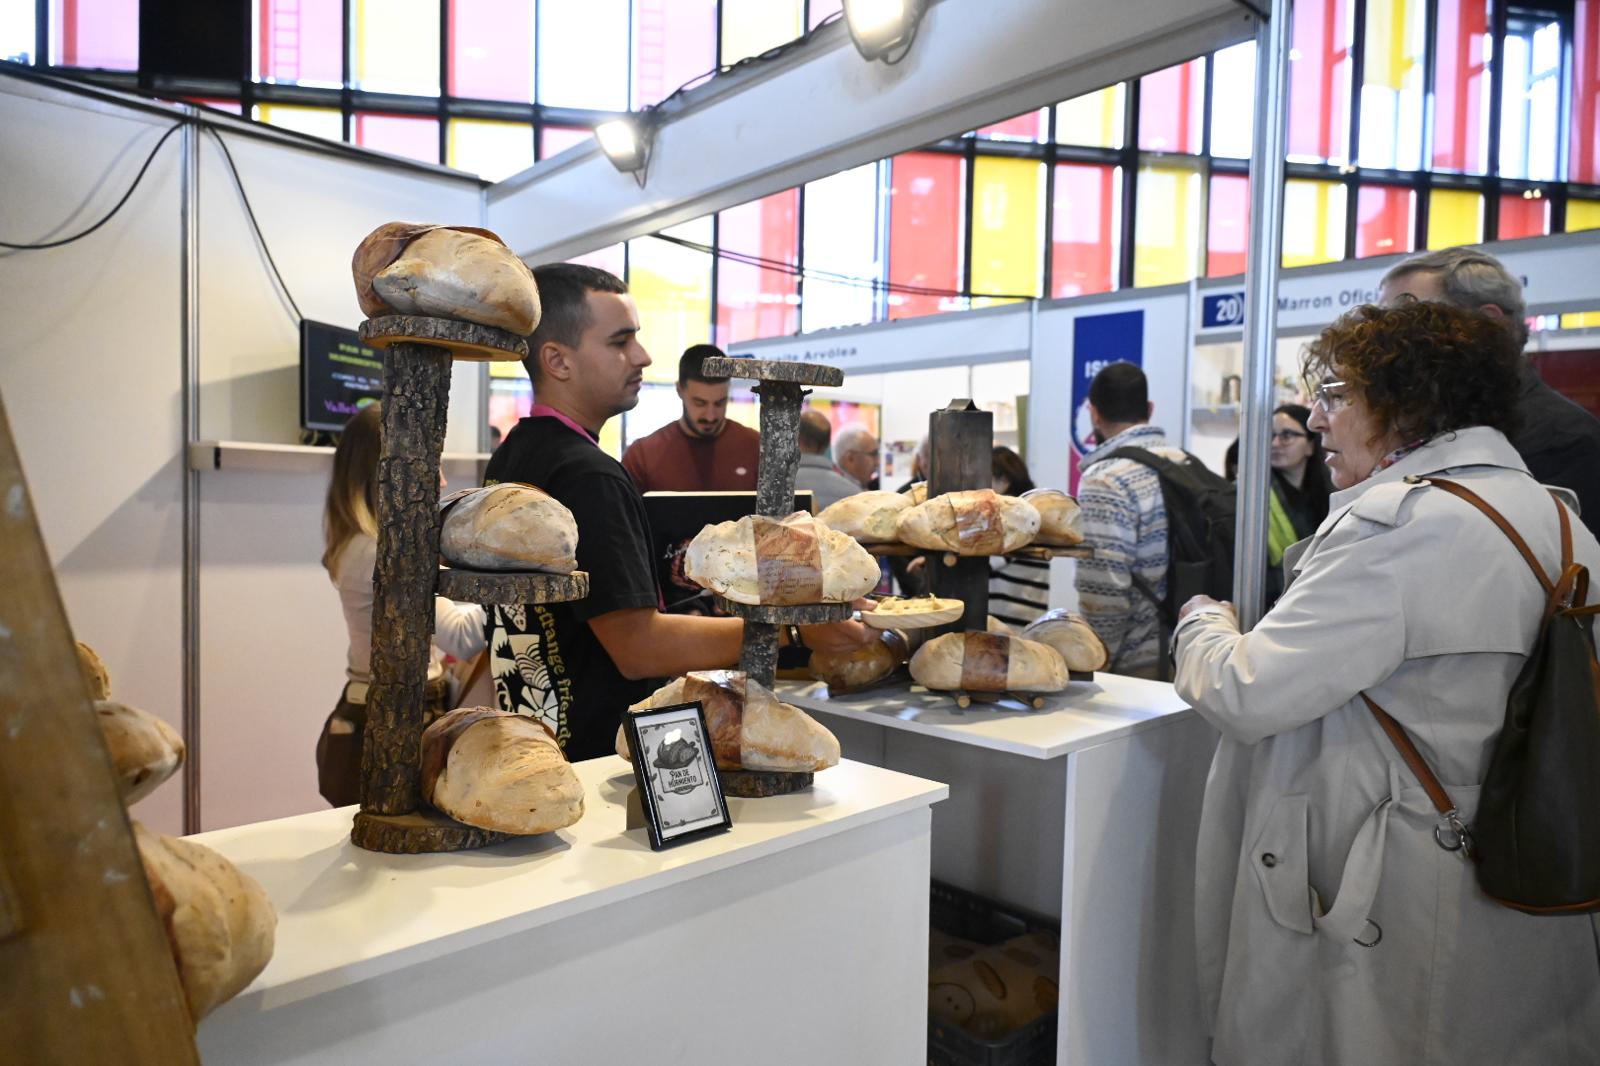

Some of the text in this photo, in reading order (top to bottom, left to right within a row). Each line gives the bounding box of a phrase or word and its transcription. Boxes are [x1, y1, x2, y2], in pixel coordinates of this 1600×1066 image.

[1216, 299, 1238, 322] 20
[1278, 289, 1378, 311] Marron Ofici
[534, 605, 566, 675] strange
[669, 770, 682, 779] PAN
